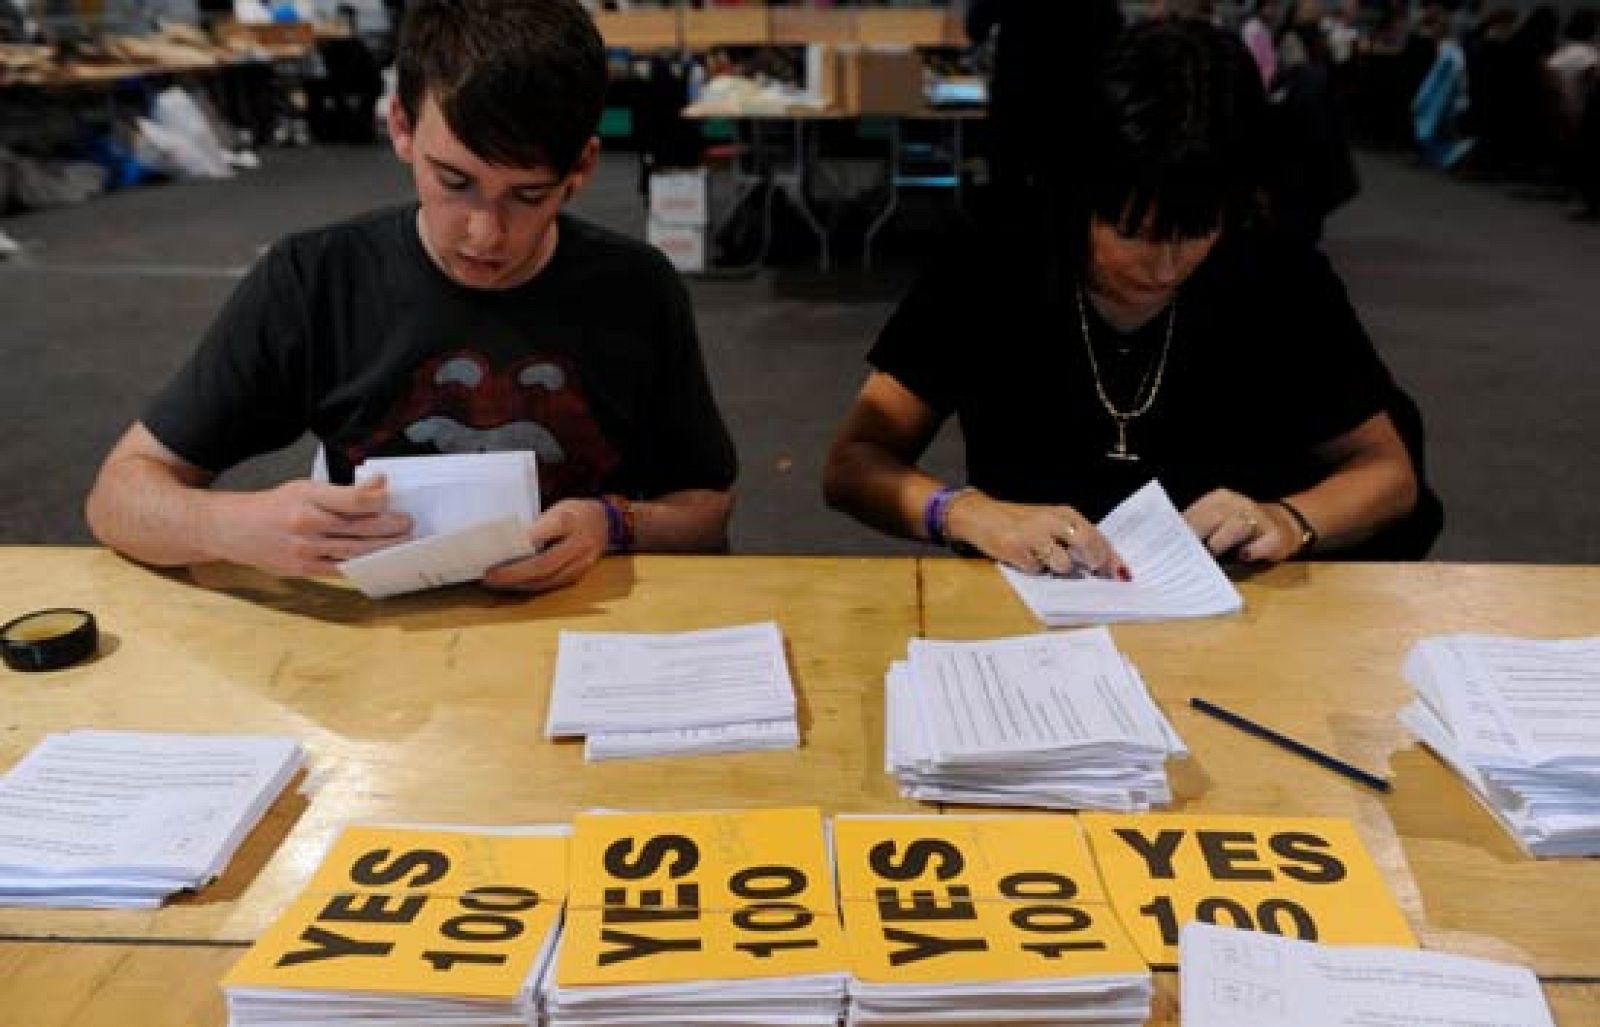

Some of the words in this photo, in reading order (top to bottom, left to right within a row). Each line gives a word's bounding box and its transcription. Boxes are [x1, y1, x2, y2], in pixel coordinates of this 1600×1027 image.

[597, 834, 701, 967] YES
[1113, 828, 1347, 883] YES
[275, 848, 450, 967] YES
[421, 886, 539, 971] 100
[728, 865, 818, 958] 100
[868, 838, 988, 967] YES
[998, 871, 1106, 959] 100
